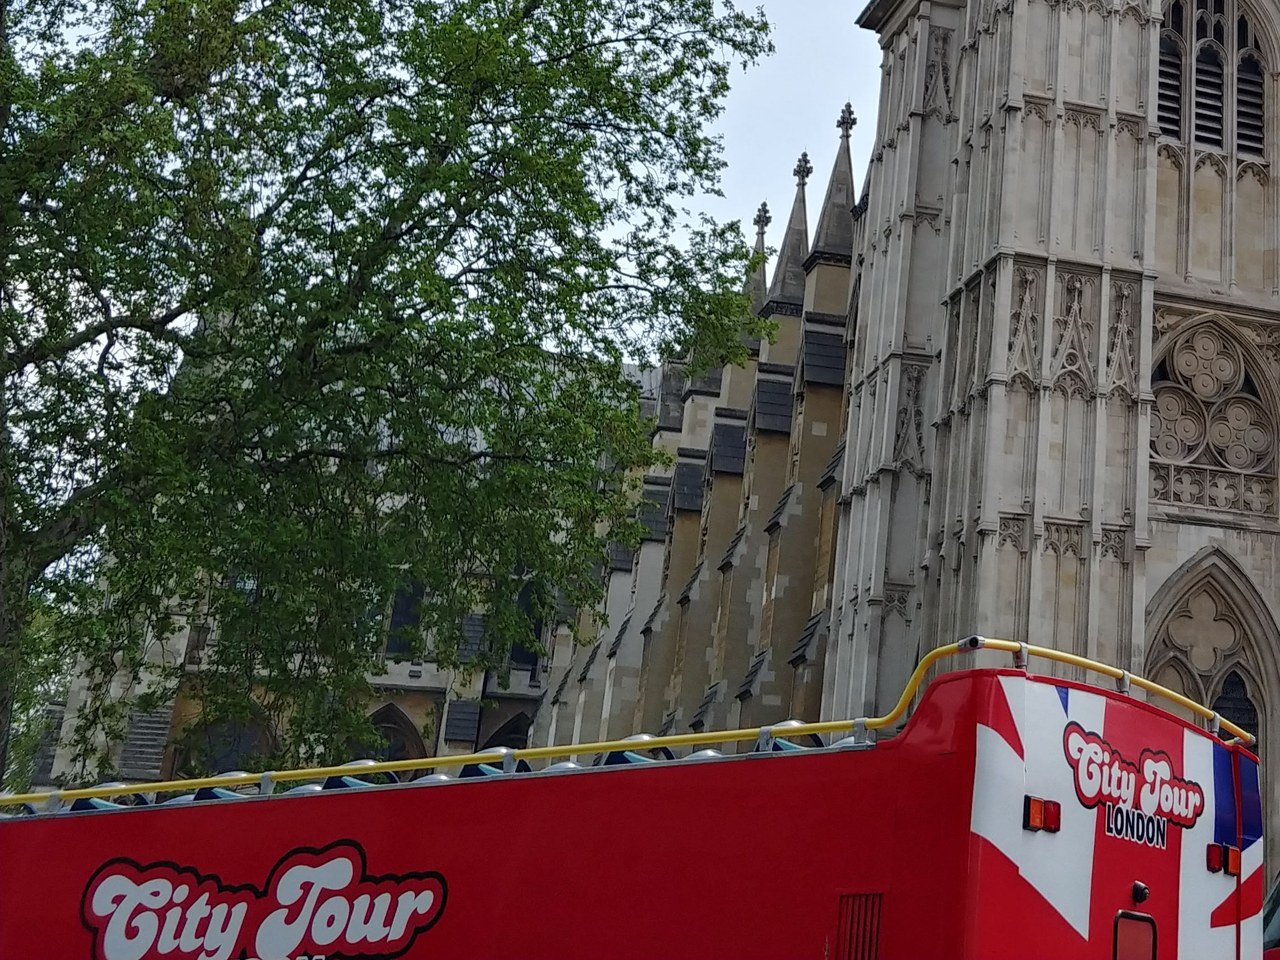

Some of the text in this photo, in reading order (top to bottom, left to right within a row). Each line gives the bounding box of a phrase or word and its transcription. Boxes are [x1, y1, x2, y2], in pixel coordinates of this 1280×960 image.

[1068, 732, 1201, 818] City Tour
[1106, 803, 1167, 849] LONDON
[92, 857, 434, 960] City Tour
